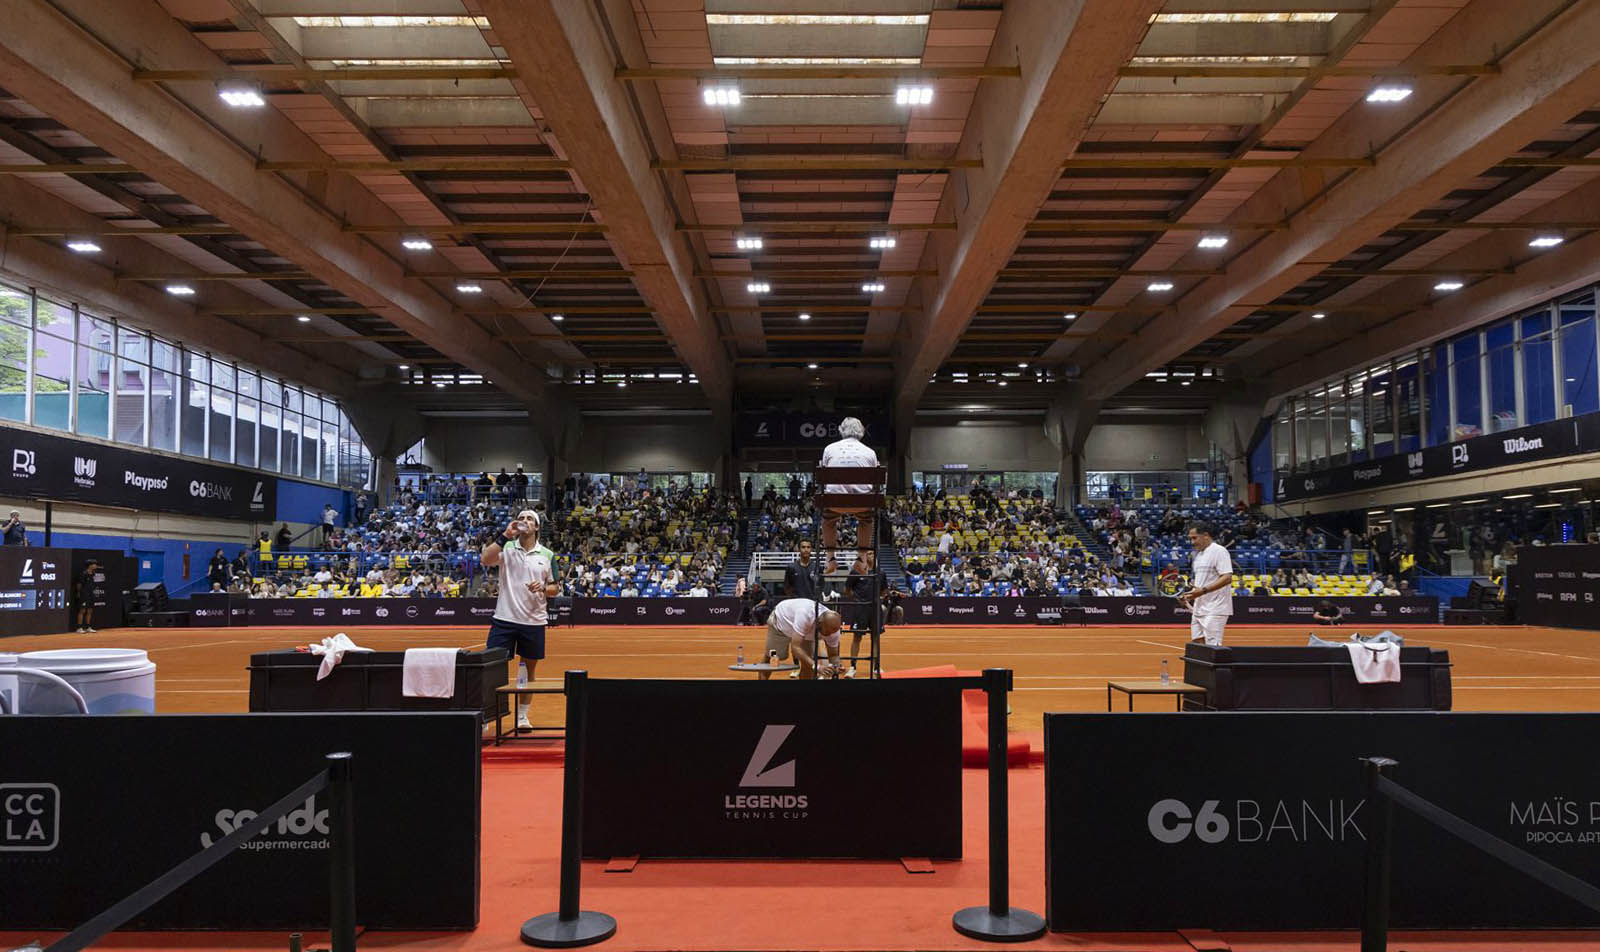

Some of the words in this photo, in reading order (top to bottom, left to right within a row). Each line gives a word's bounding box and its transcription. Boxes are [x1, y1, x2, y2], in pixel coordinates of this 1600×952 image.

[1503, 436, 1544, 454] Wilson
[125, 470, 169, 491] Playpiso
[725, 795, 808, 809] LEGENDS
[725, 811, 777, 820] TENNIS
[783, 811, 809, 820] CUP
[1509, 796, 1579, 826] MAÏS
[1526, 831, 1573, 844] PIPOCA
